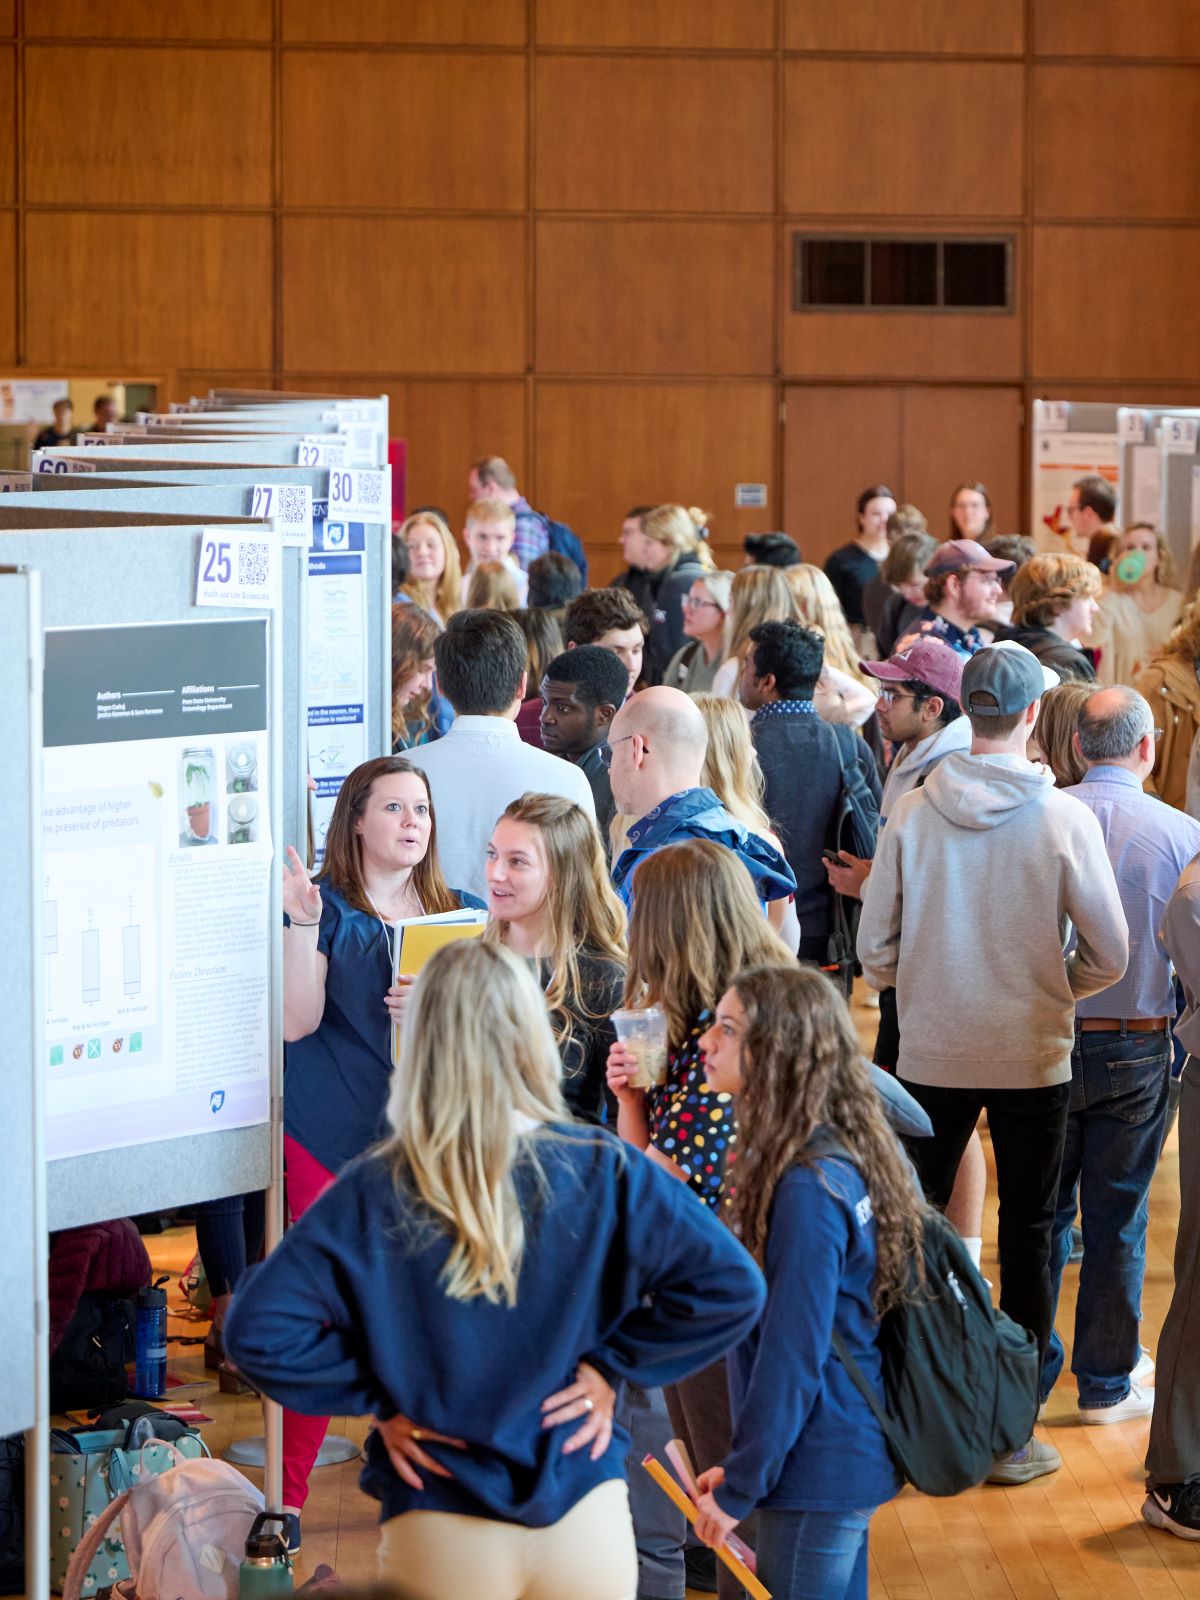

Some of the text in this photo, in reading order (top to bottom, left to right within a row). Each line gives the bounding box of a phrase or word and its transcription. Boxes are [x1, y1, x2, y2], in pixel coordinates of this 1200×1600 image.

[1172, 422, 1181, 440] 5
[332, 472, 352, 502] 30
[254, 487, 273, 517] 27
[203, 541, 231, 583] 25
[231, 591, 240, 600] Life
[242, 591, 270, 601] Sciences
[97, 691, 122, 700] Authors
[181, 685, 215, 695] Affiliations
[55, 804, 97, 819] advantage
[98, 801, 107, 813] of
[107, 800, 132, 814] higher
[55, 820, 91, 835] presence
[92, 819, 101, 830] of
[102, 816, 140, 831] predators
[194, 965, 227, 977] Direction
